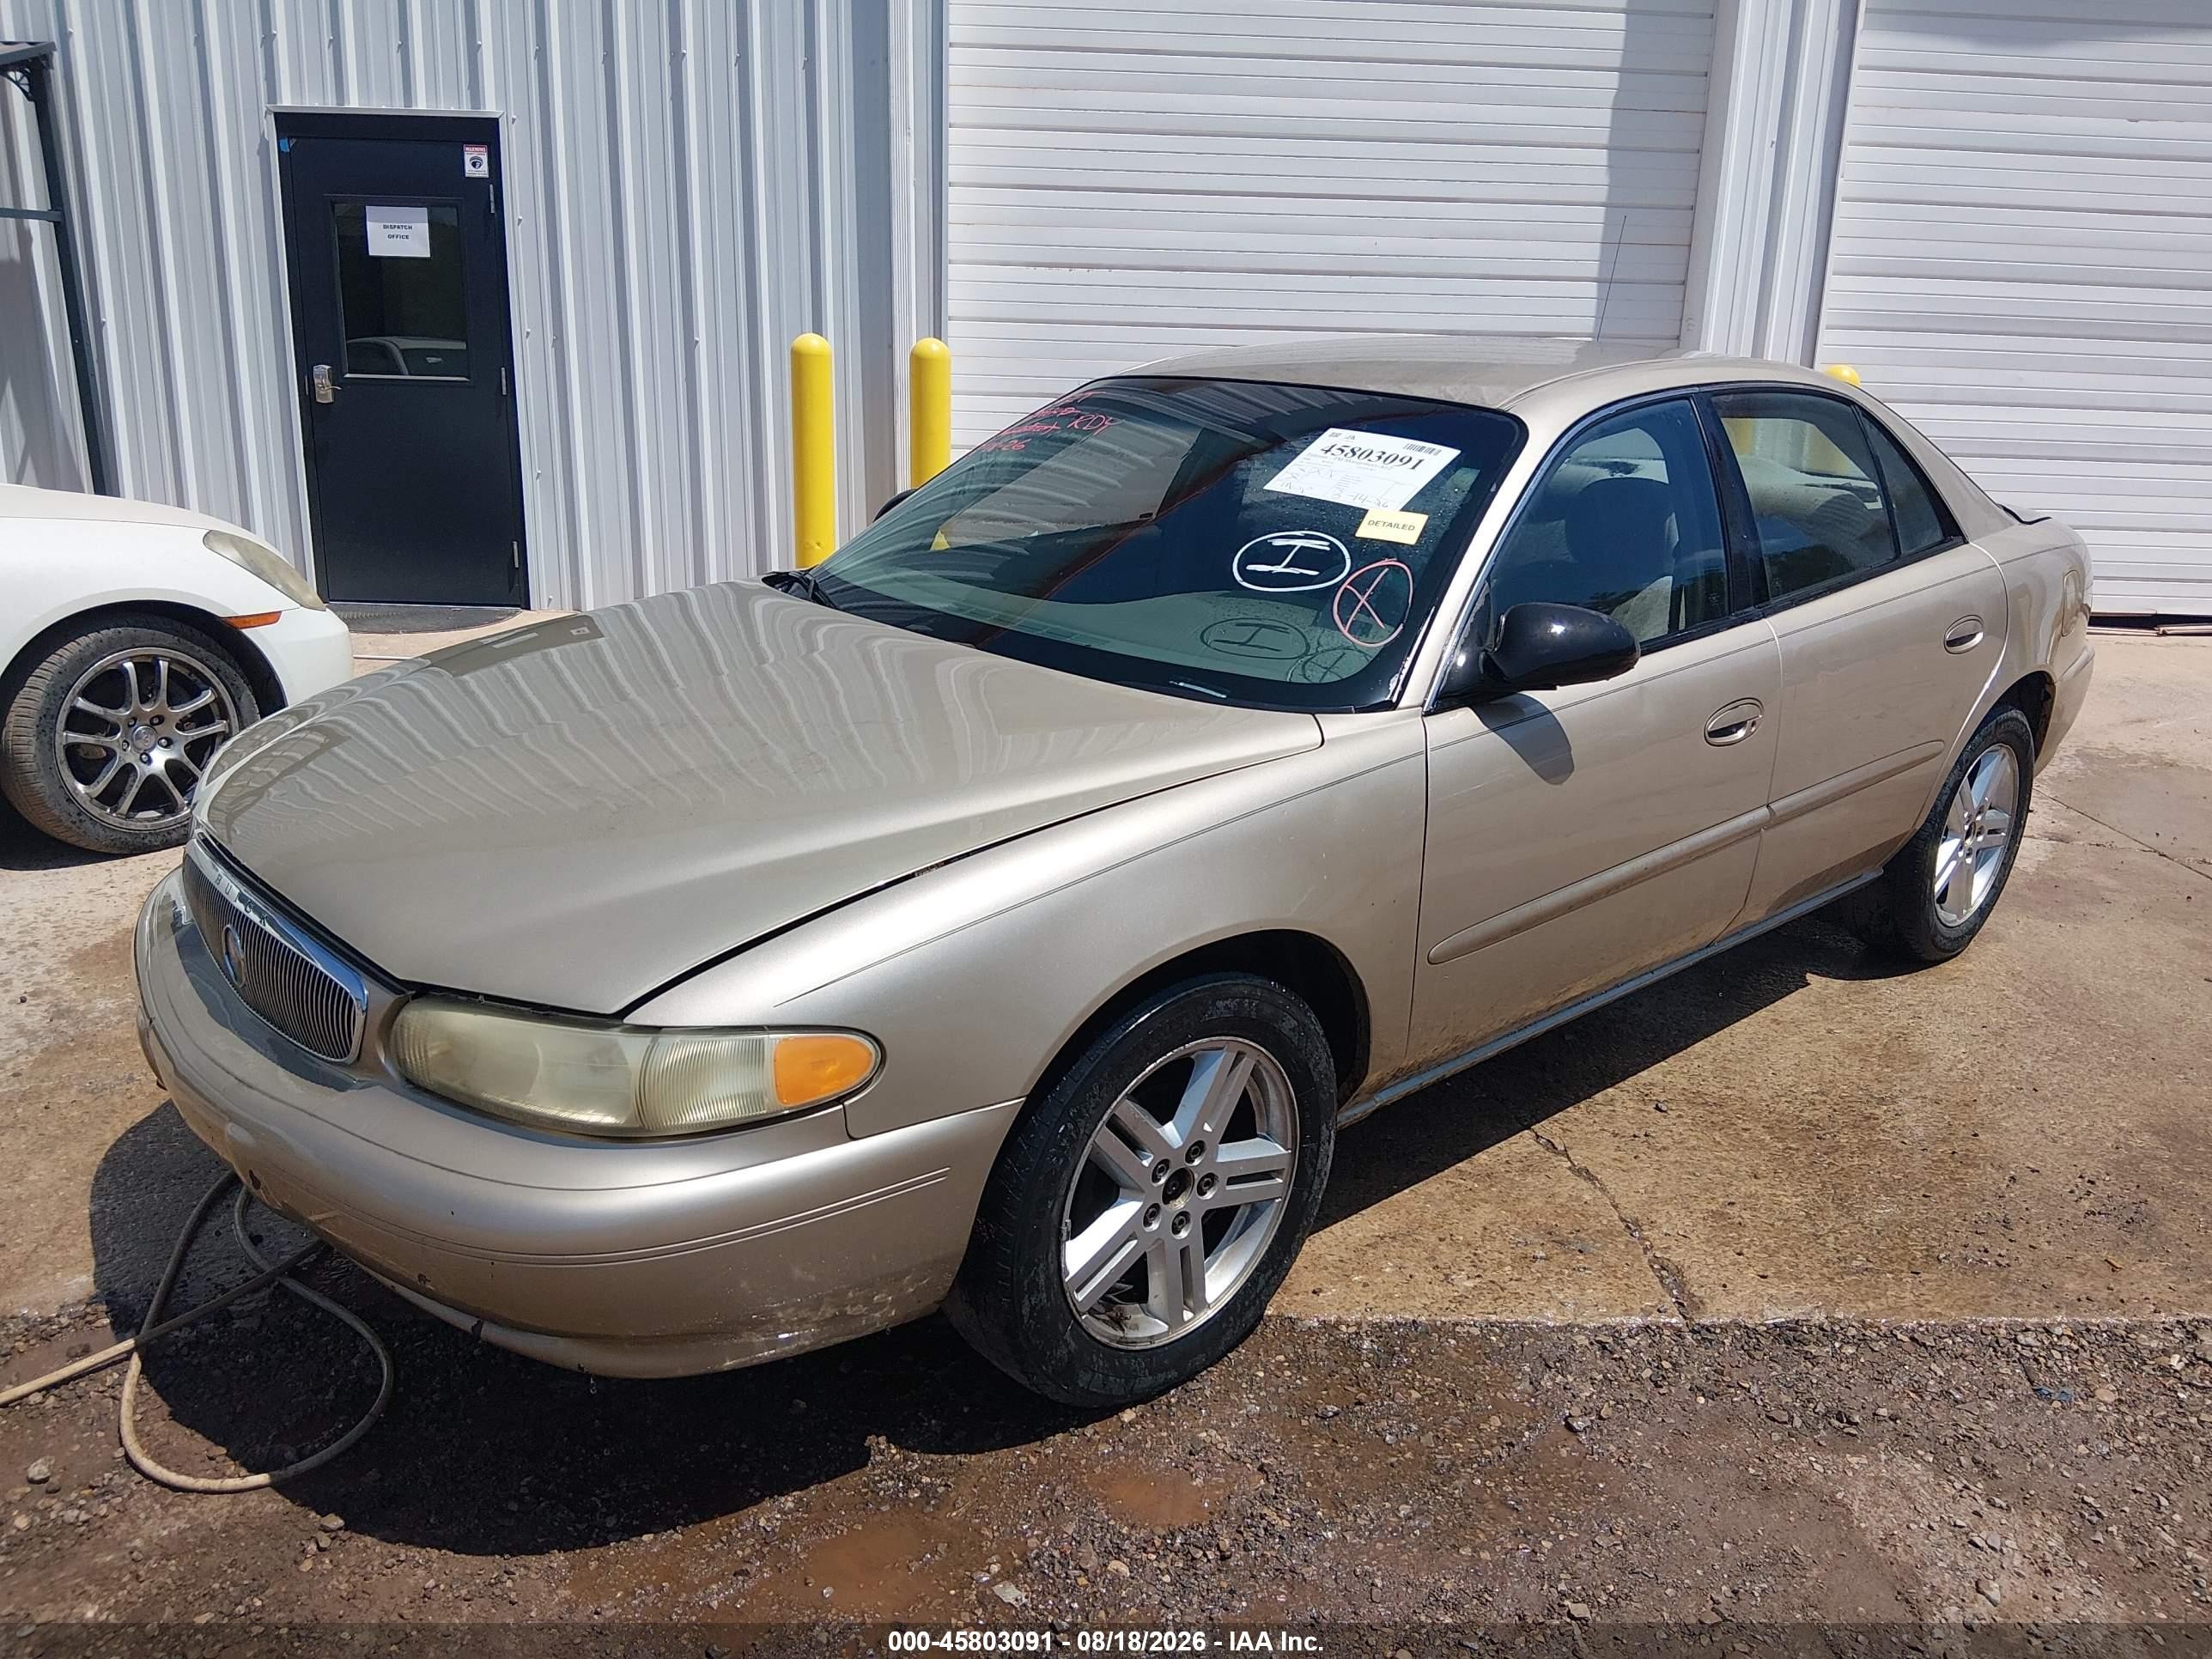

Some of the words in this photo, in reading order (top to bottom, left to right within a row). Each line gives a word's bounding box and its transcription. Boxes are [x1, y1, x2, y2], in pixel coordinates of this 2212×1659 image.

[1320, 442, 1426, 471] 45803091
[1367, 520, 1416, 532] DETAILED
[215, 873, 268, 927] BUICK
